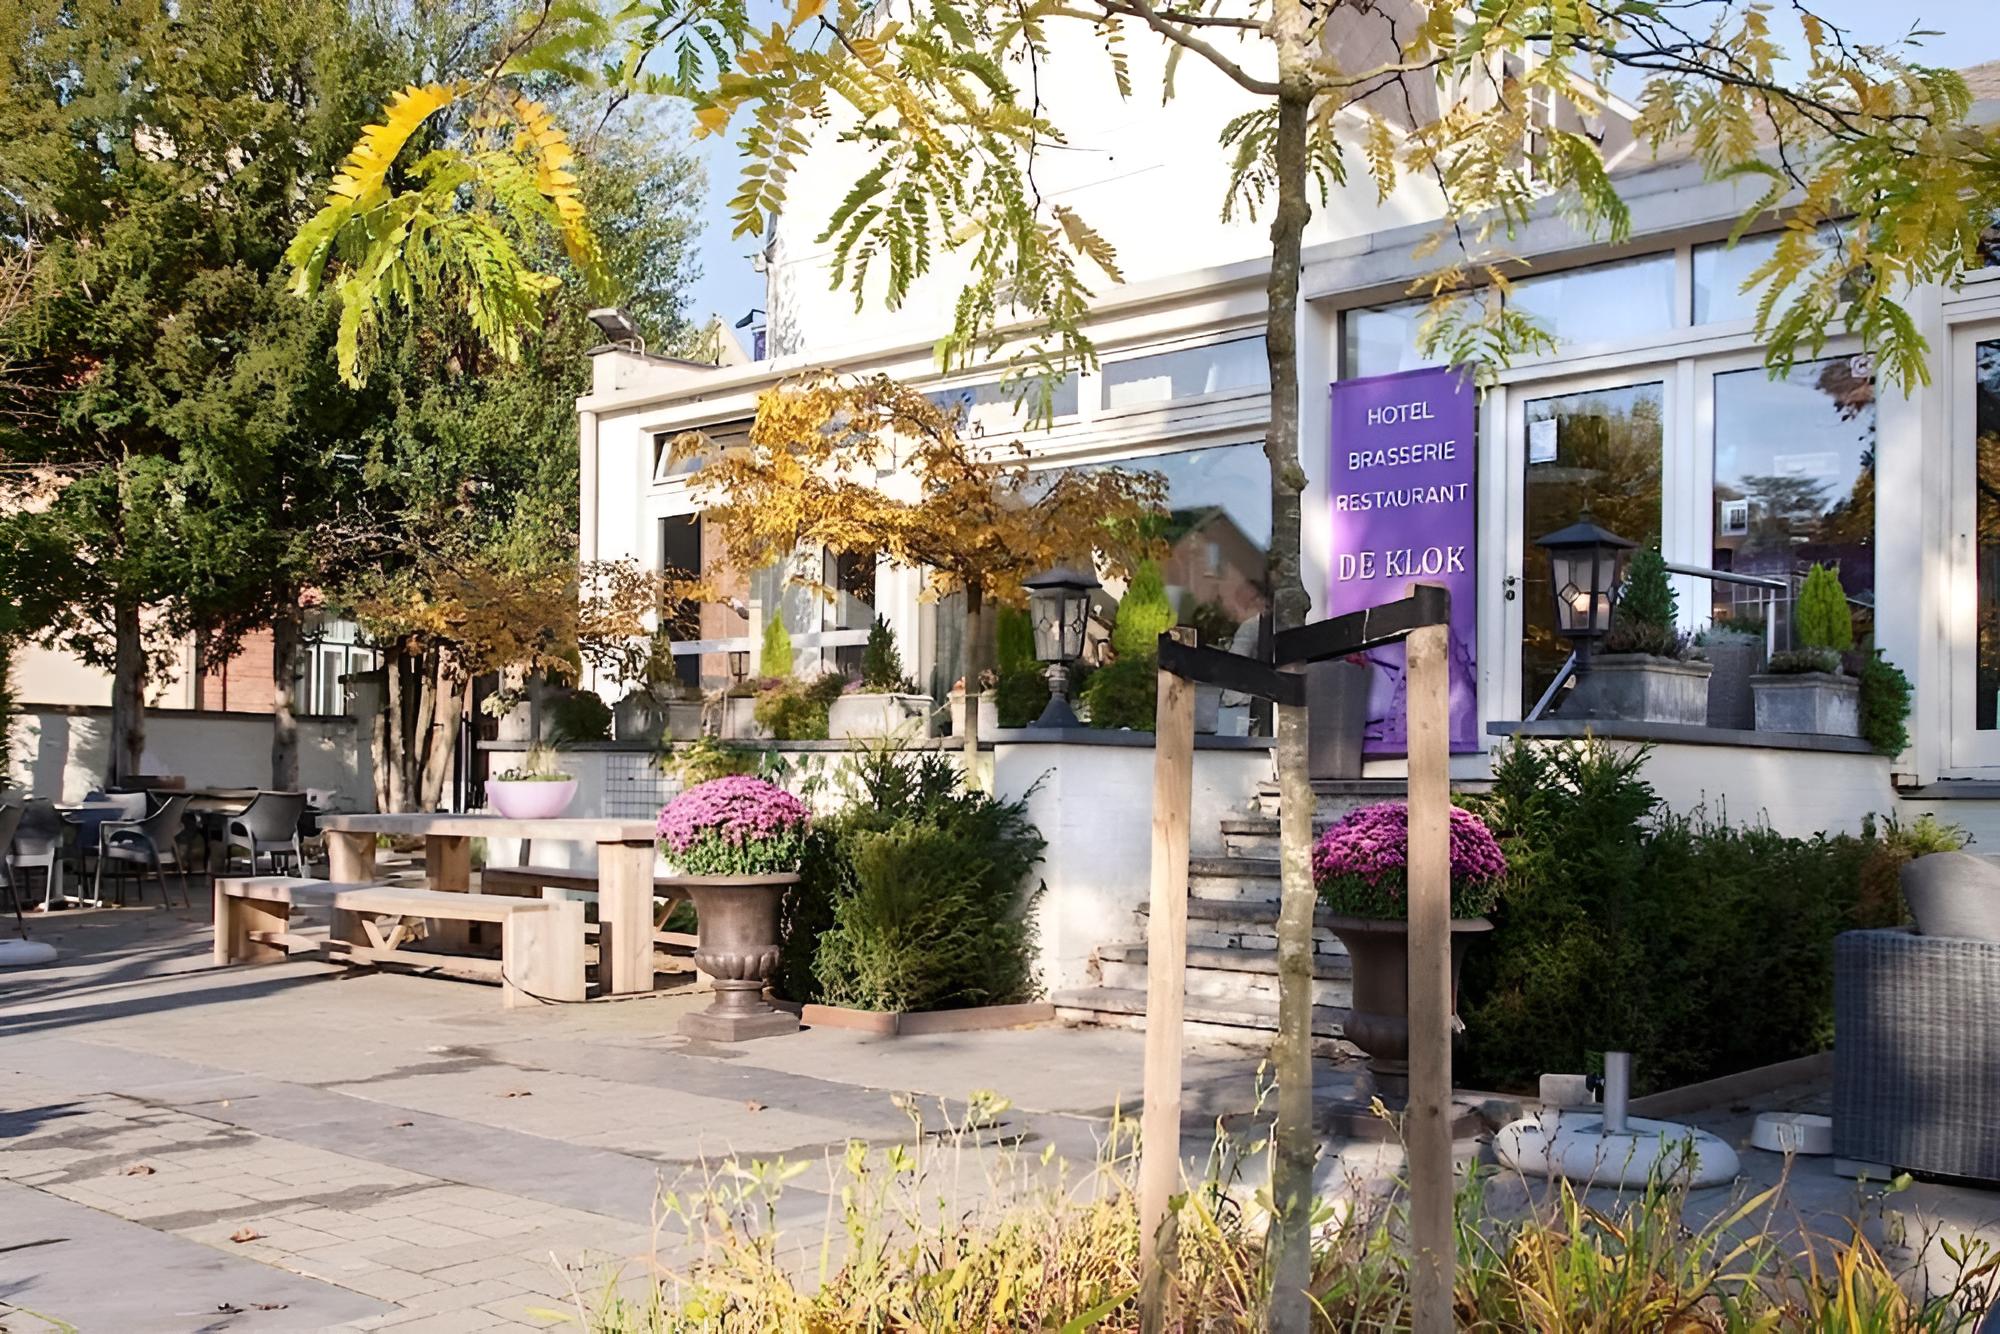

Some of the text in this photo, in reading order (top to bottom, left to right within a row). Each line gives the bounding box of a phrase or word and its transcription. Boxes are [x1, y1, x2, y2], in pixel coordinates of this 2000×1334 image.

[1367, 401, 1435, 426] HOTEL
[1348, 440, 1456, 470] BRASSERIE
[1336, 483, 1468, 512] RESTAURANT
[1337, 546, 1465, 581] DE KLOK
